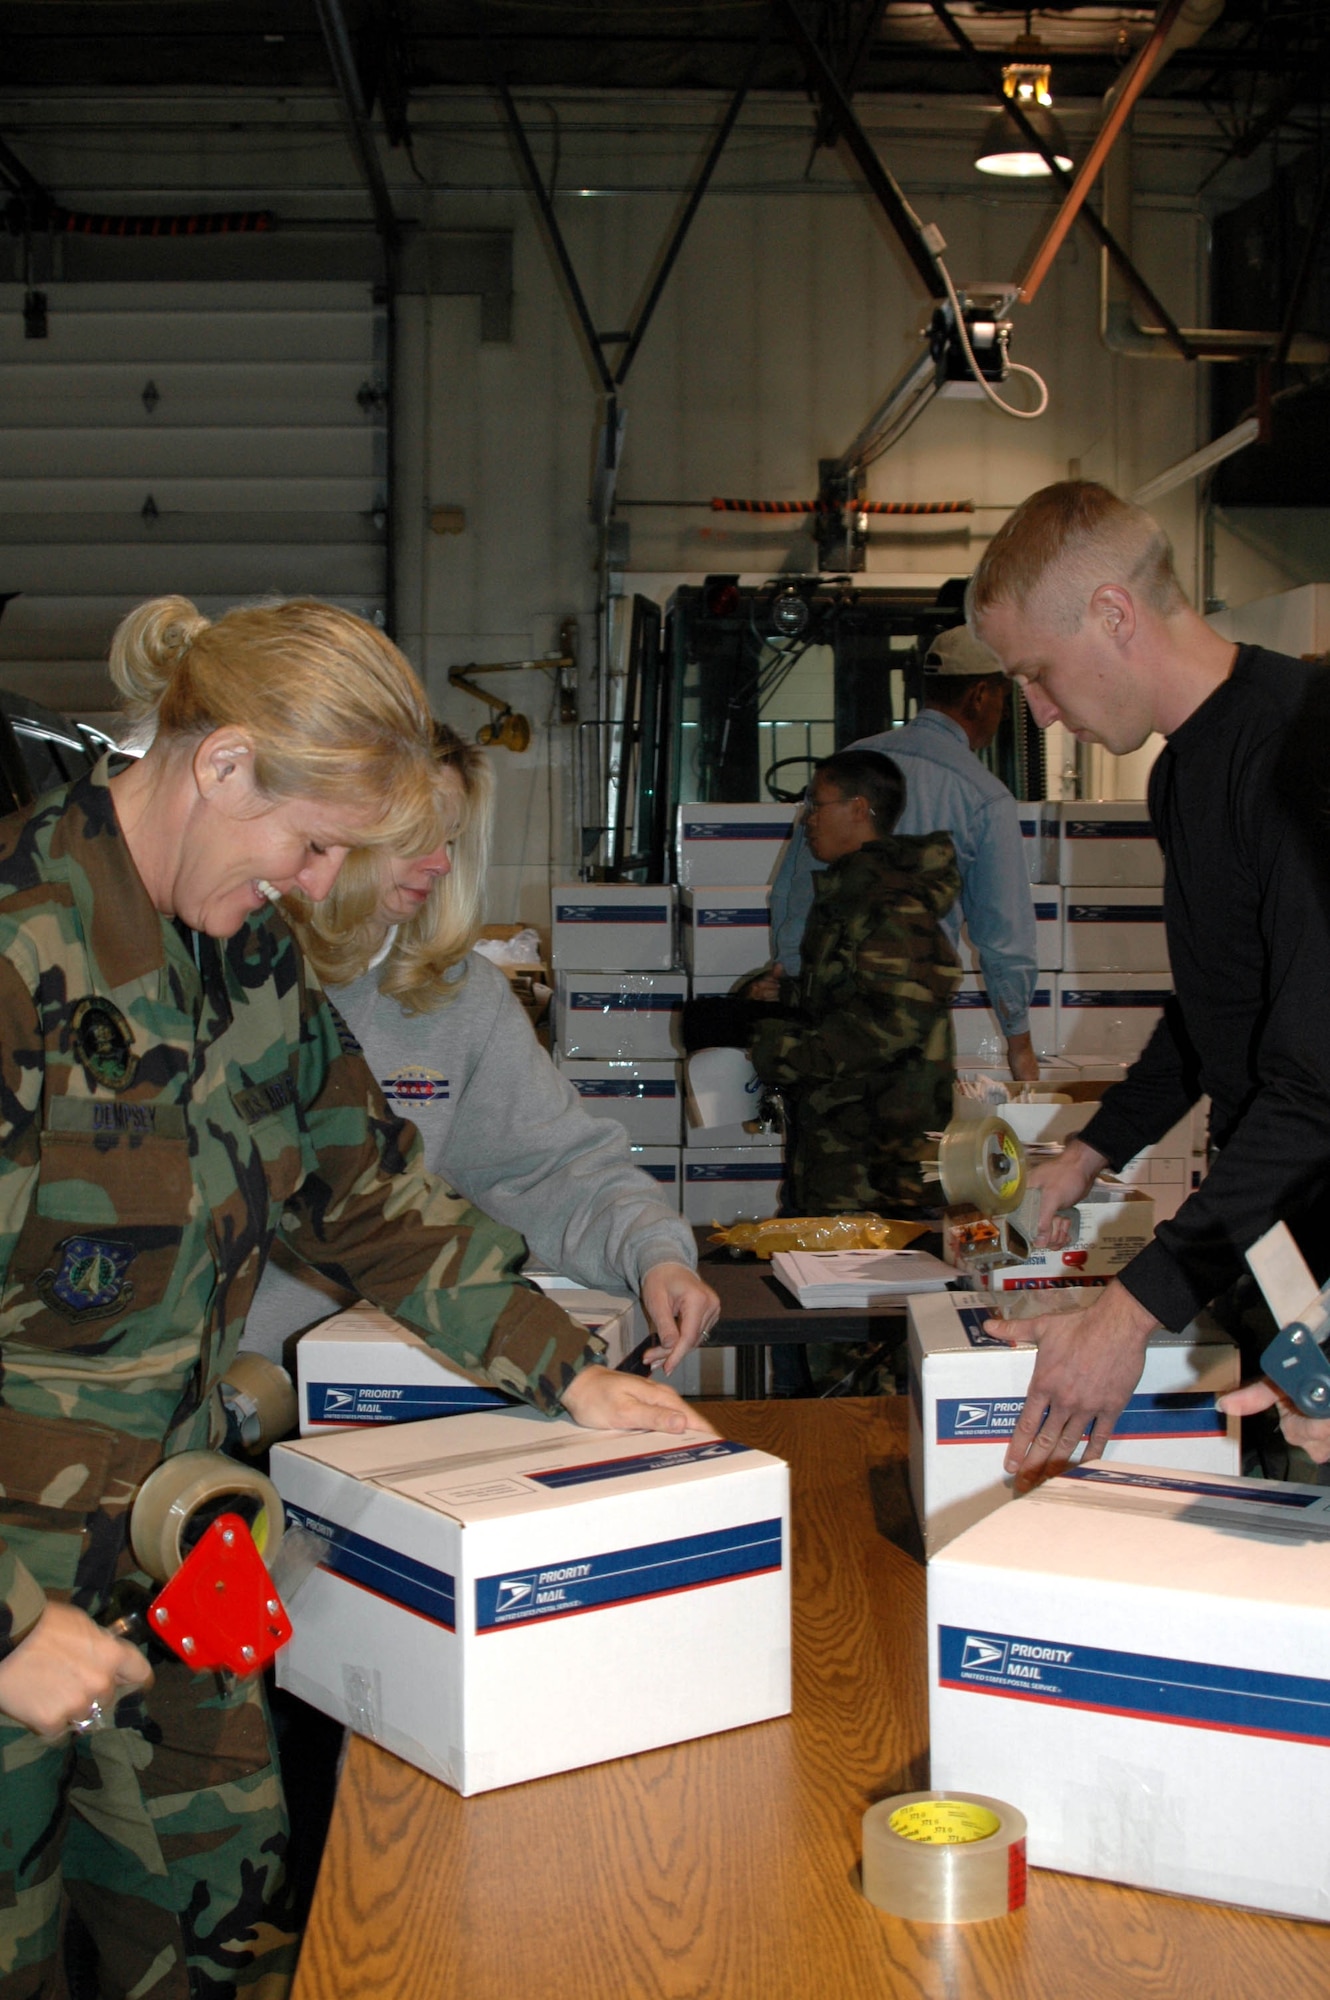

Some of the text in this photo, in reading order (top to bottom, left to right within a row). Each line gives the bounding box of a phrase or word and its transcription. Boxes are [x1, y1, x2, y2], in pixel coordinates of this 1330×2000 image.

[93, 1103, 156, 1131] DEMPSEY
[358, 1389, 403, 1399] PRIORITY
[356, 1403, 382, 1413] MAIL
[990, 1417, 1016, 1427] MAIL
[539, 1563, 592, 1584] PRIORITY
[535, 1588, 567, 1604] MAIL
[1010, 1643, 1074, 1664] PRIORITY
[960, 1671, 985, 1681] UNITED
[985, 1675, 1007, 1685] STATES
[1007, 1678, 1030, 1688] POSTAL
[1006, 1663, 1042, 1680] MAIL
